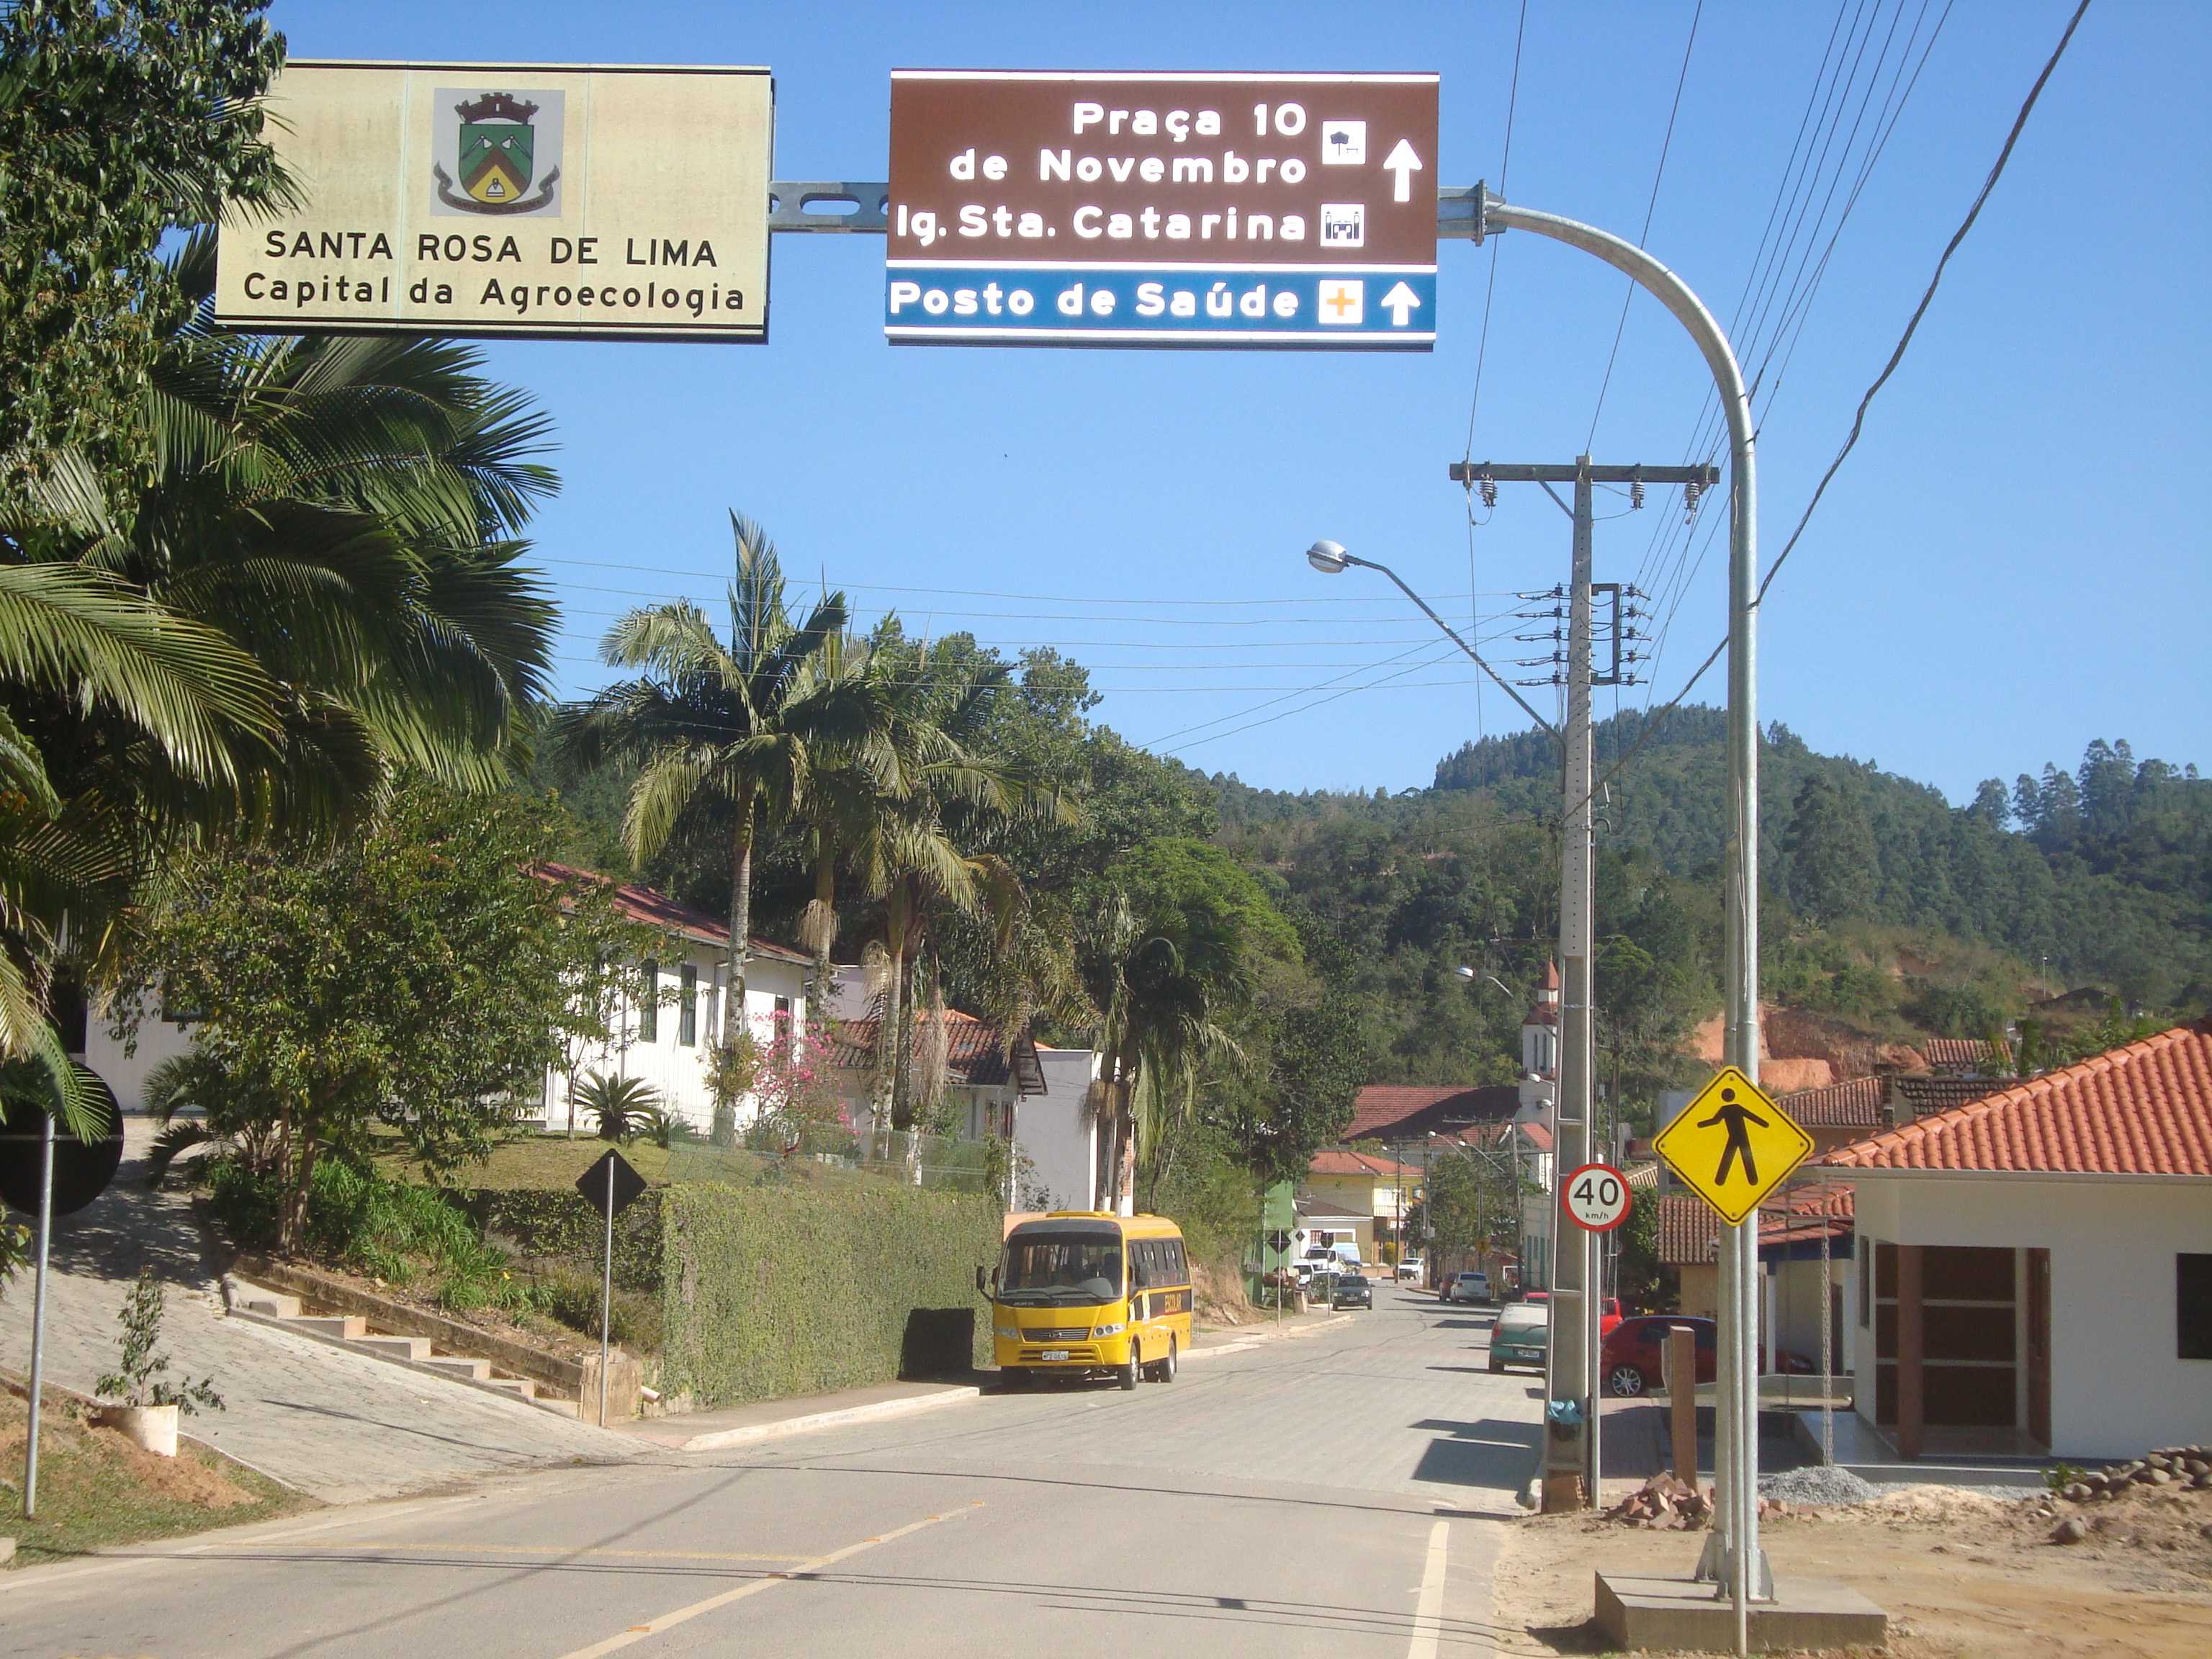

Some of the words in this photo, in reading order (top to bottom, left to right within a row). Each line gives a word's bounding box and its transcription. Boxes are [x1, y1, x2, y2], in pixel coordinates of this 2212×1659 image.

[1074, 102, 1221, 143] Praça
[1254, 102, 1307, 136] 10
[949, 148, 1008, 181] de
[1040, 148, 1307, 184] Novembro
[897, 204, 947, 247] Ig.
[958, 204, 1056, 238] Sta.
[1073, 205, 1305, 241] Catarina
[265, 230, 393, 260] SANTA
[418, 234, 522, 262] ROSA
[550, 237, 598, 264] DE
[626, 238, 717, 267] LIMA
[244, 272, 388, 308] Capital
[409, 277, 452, 304] da
[480, 278, 744, 318] Agroecologia
[890, 282, 1035, 316] Posto
[1057, 283, 1116, 315] de
[1136, 282, 1300, 318] Saúde
[1573, 1177, 1619, 1206] 40
